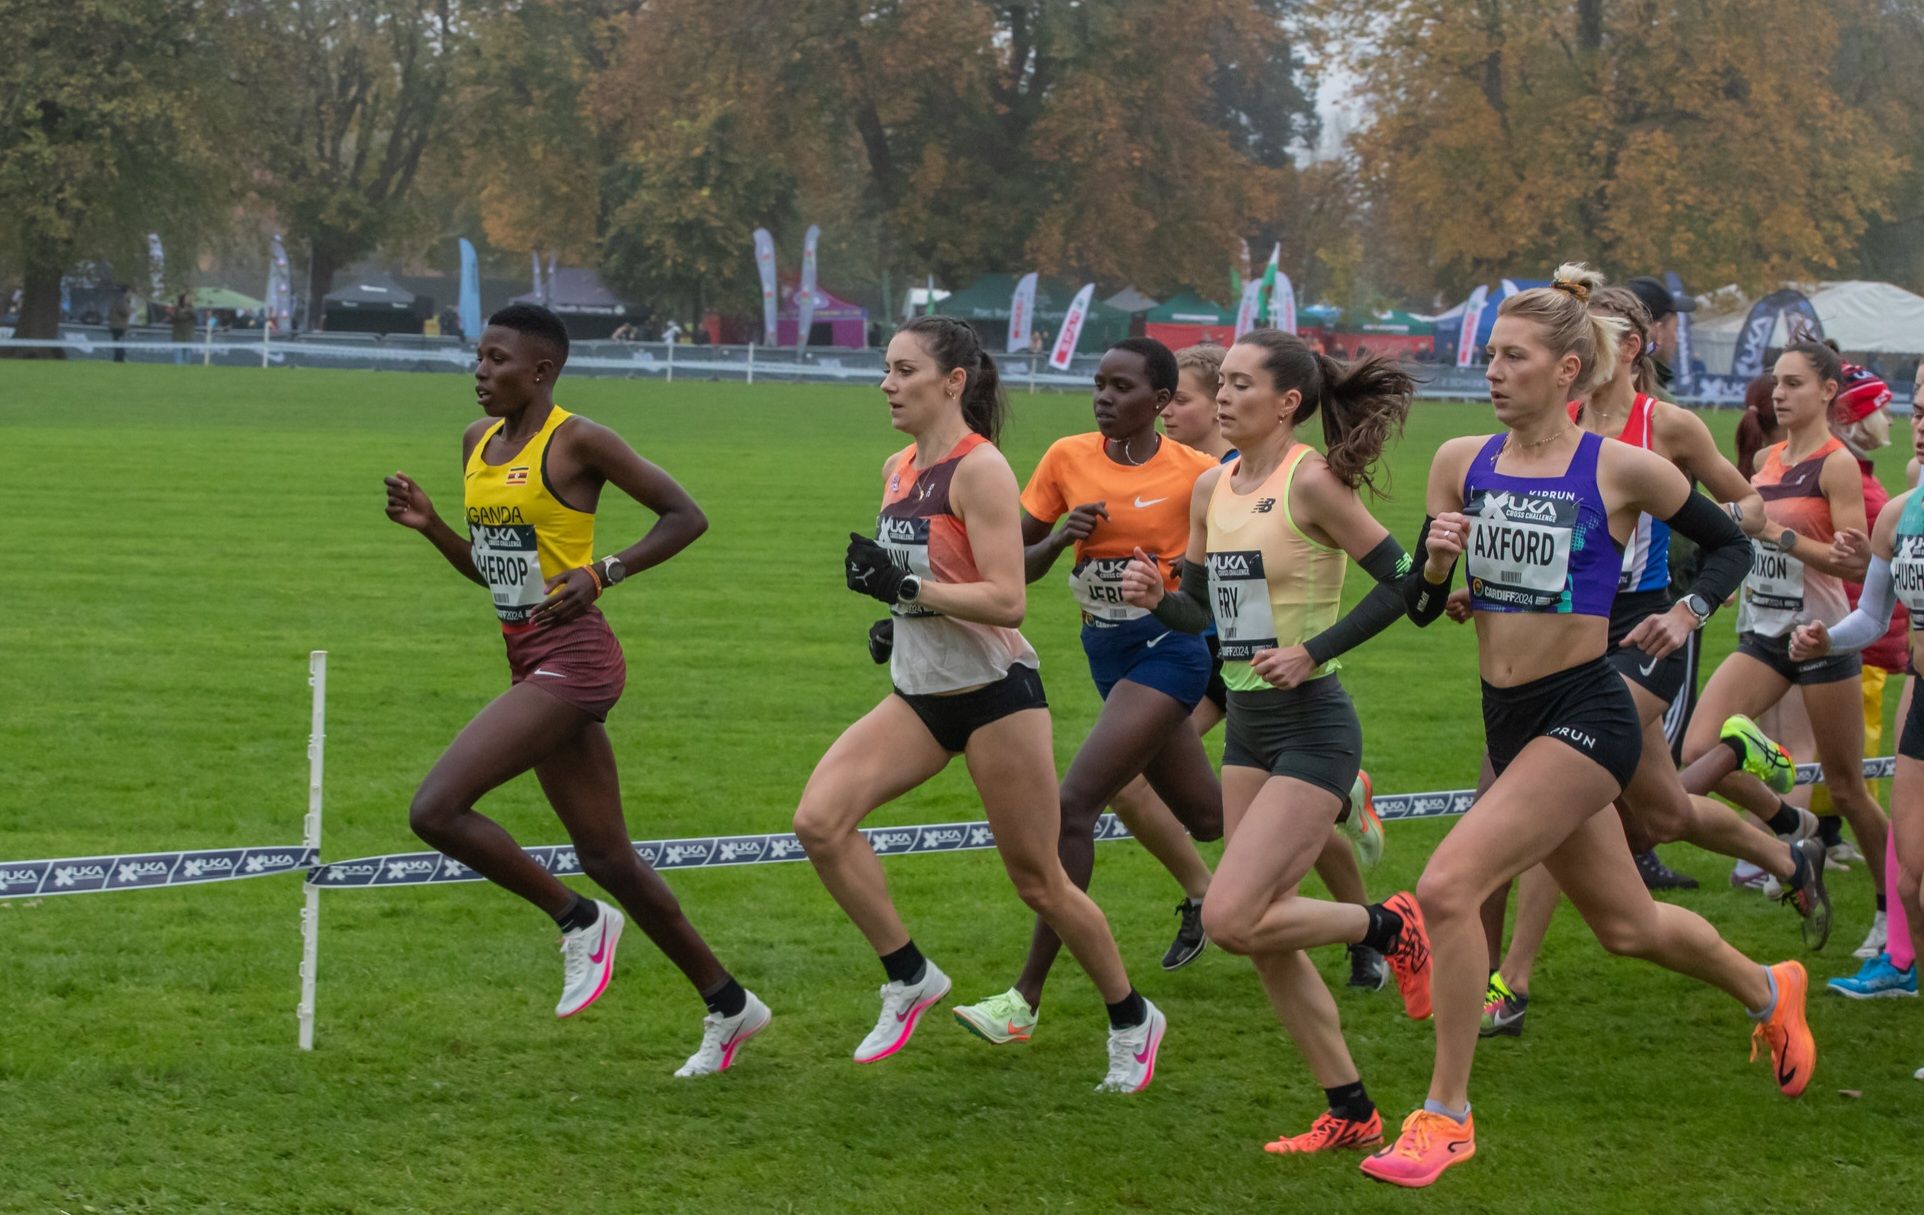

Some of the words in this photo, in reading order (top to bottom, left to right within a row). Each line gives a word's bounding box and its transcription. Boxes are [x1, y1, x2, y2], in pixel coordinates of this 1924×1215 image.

[467, 506, 524, 524] GANDA
[1506, 509, 1525, 519] CROSS
[1508, 496, 1557, 516] UKA
[1474, 523, 1555, 567] AXFORD
[477, 554, 529, 587] HEROP
[1098, 561, 1127, 573] UK
[1218, 555, 1249, 569] UKA
[1751, 553, 1787, 580] IXON
[1217, 586, 1239, 619] FRY
